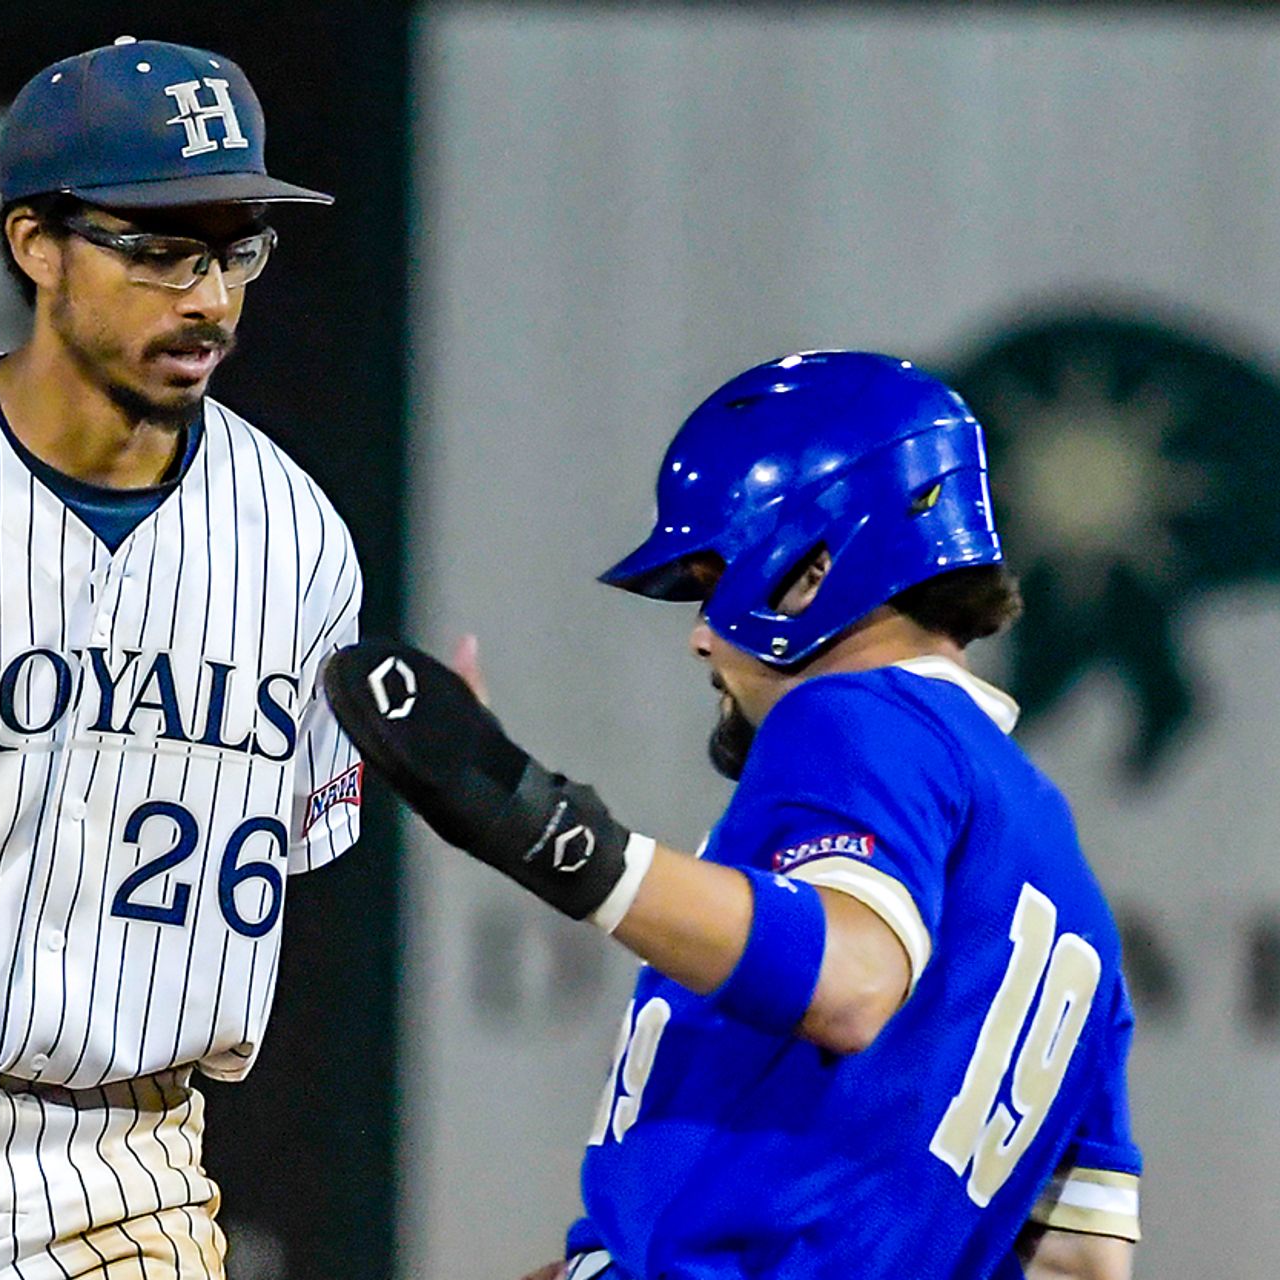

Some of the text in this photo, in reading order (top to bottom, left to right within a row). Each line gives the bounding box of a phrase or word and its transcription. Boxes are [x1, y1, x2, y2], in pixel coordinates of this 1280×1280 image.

[164, 77, 249, 158] H
[110, 799, 289, 940] 26
[927, 880, 1102, 1209] 19
